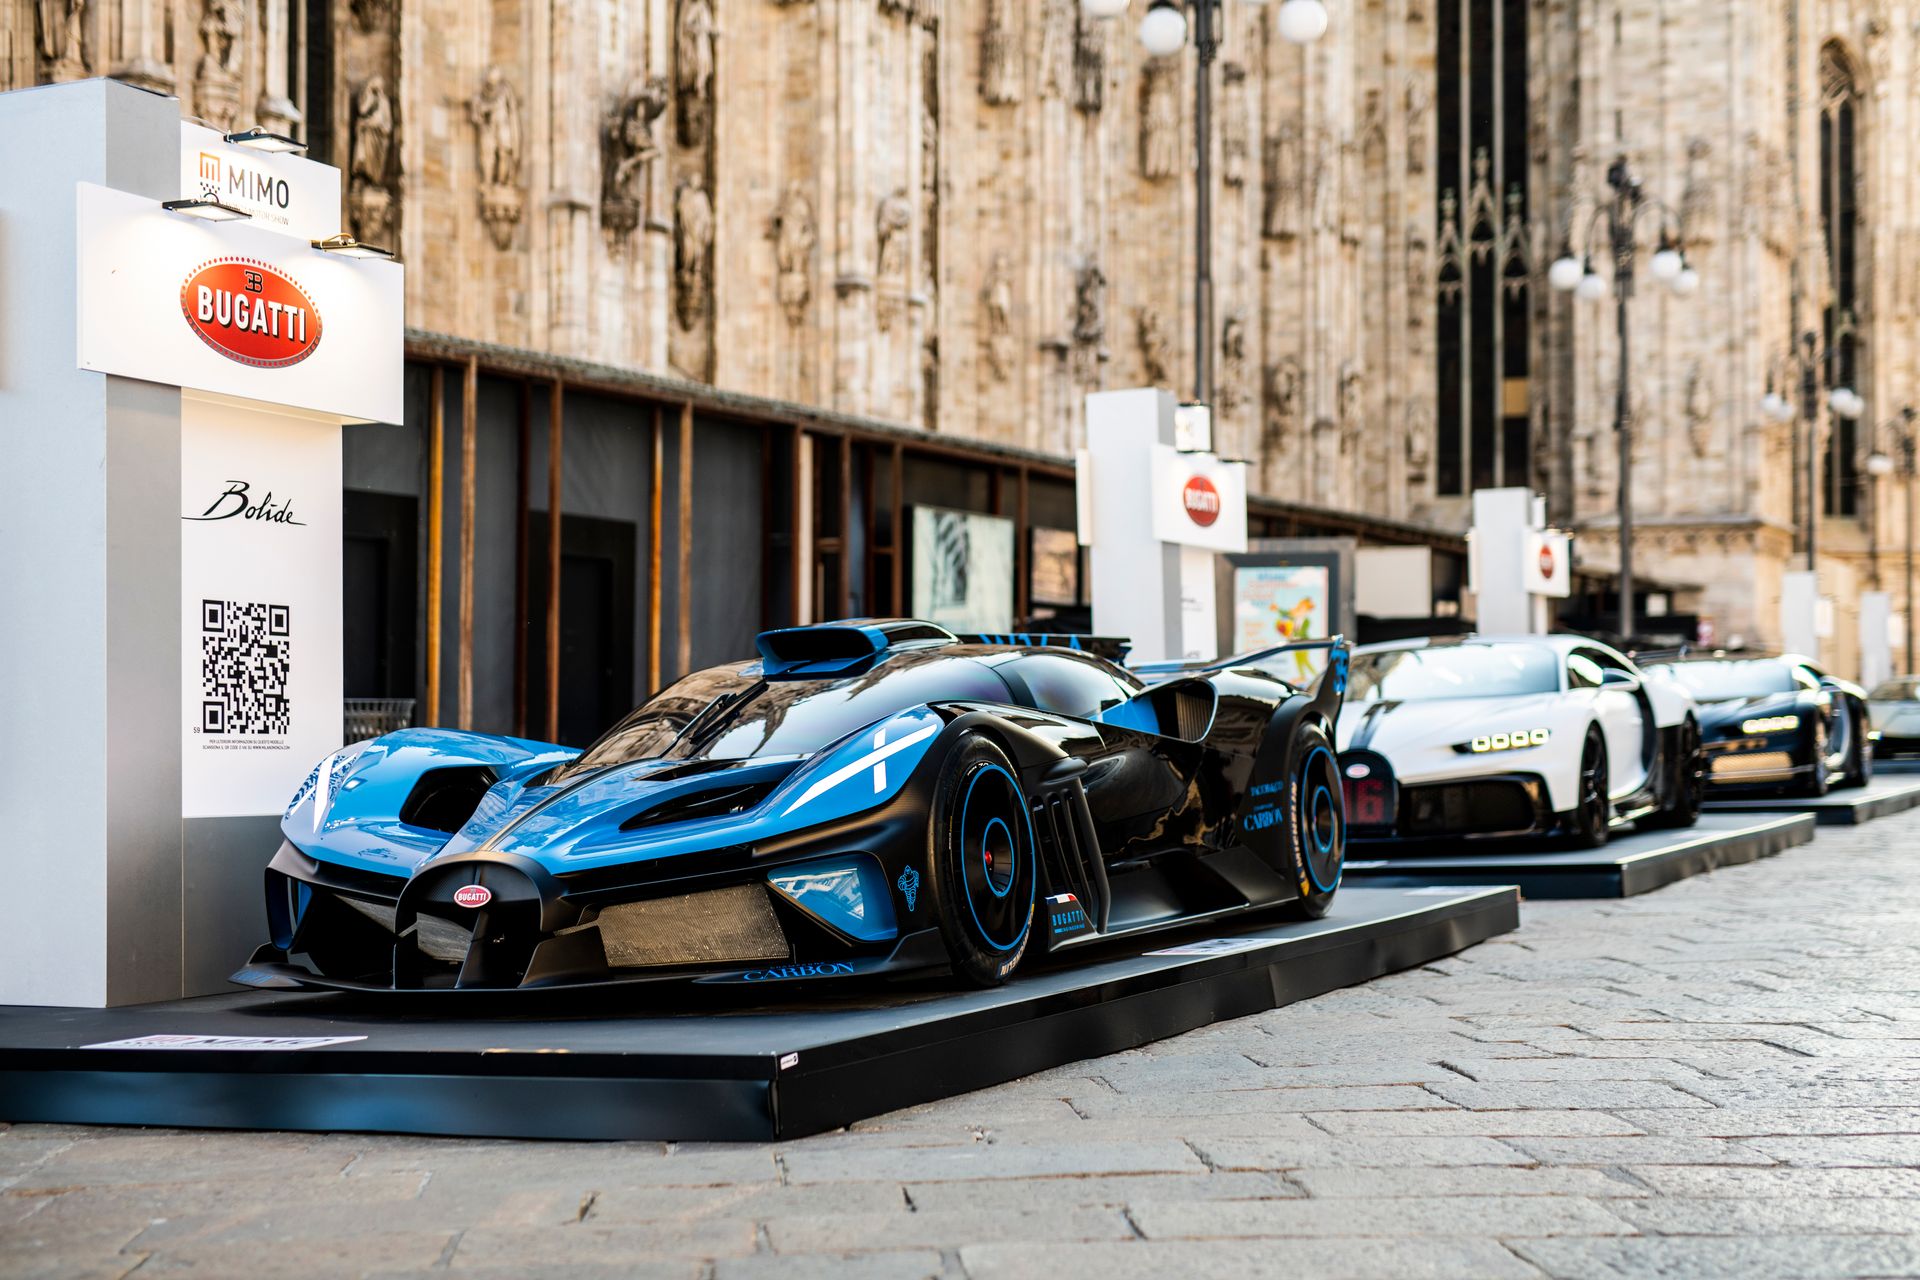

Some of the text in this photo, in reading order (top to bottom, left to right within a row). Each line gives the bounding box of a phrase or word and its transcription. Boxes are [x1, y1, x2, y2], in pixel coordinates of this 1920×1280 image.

[229, 164, 289, 209] MIMO
[198, 285, 307, 344] BUGATTI
[181, 480, 307, 526] Bolide
[458, 893, 487, 901] BUGATTI
[1052, 910, 1084, 927] BUGATTI
[743, 962, 855, 981] CARBON
